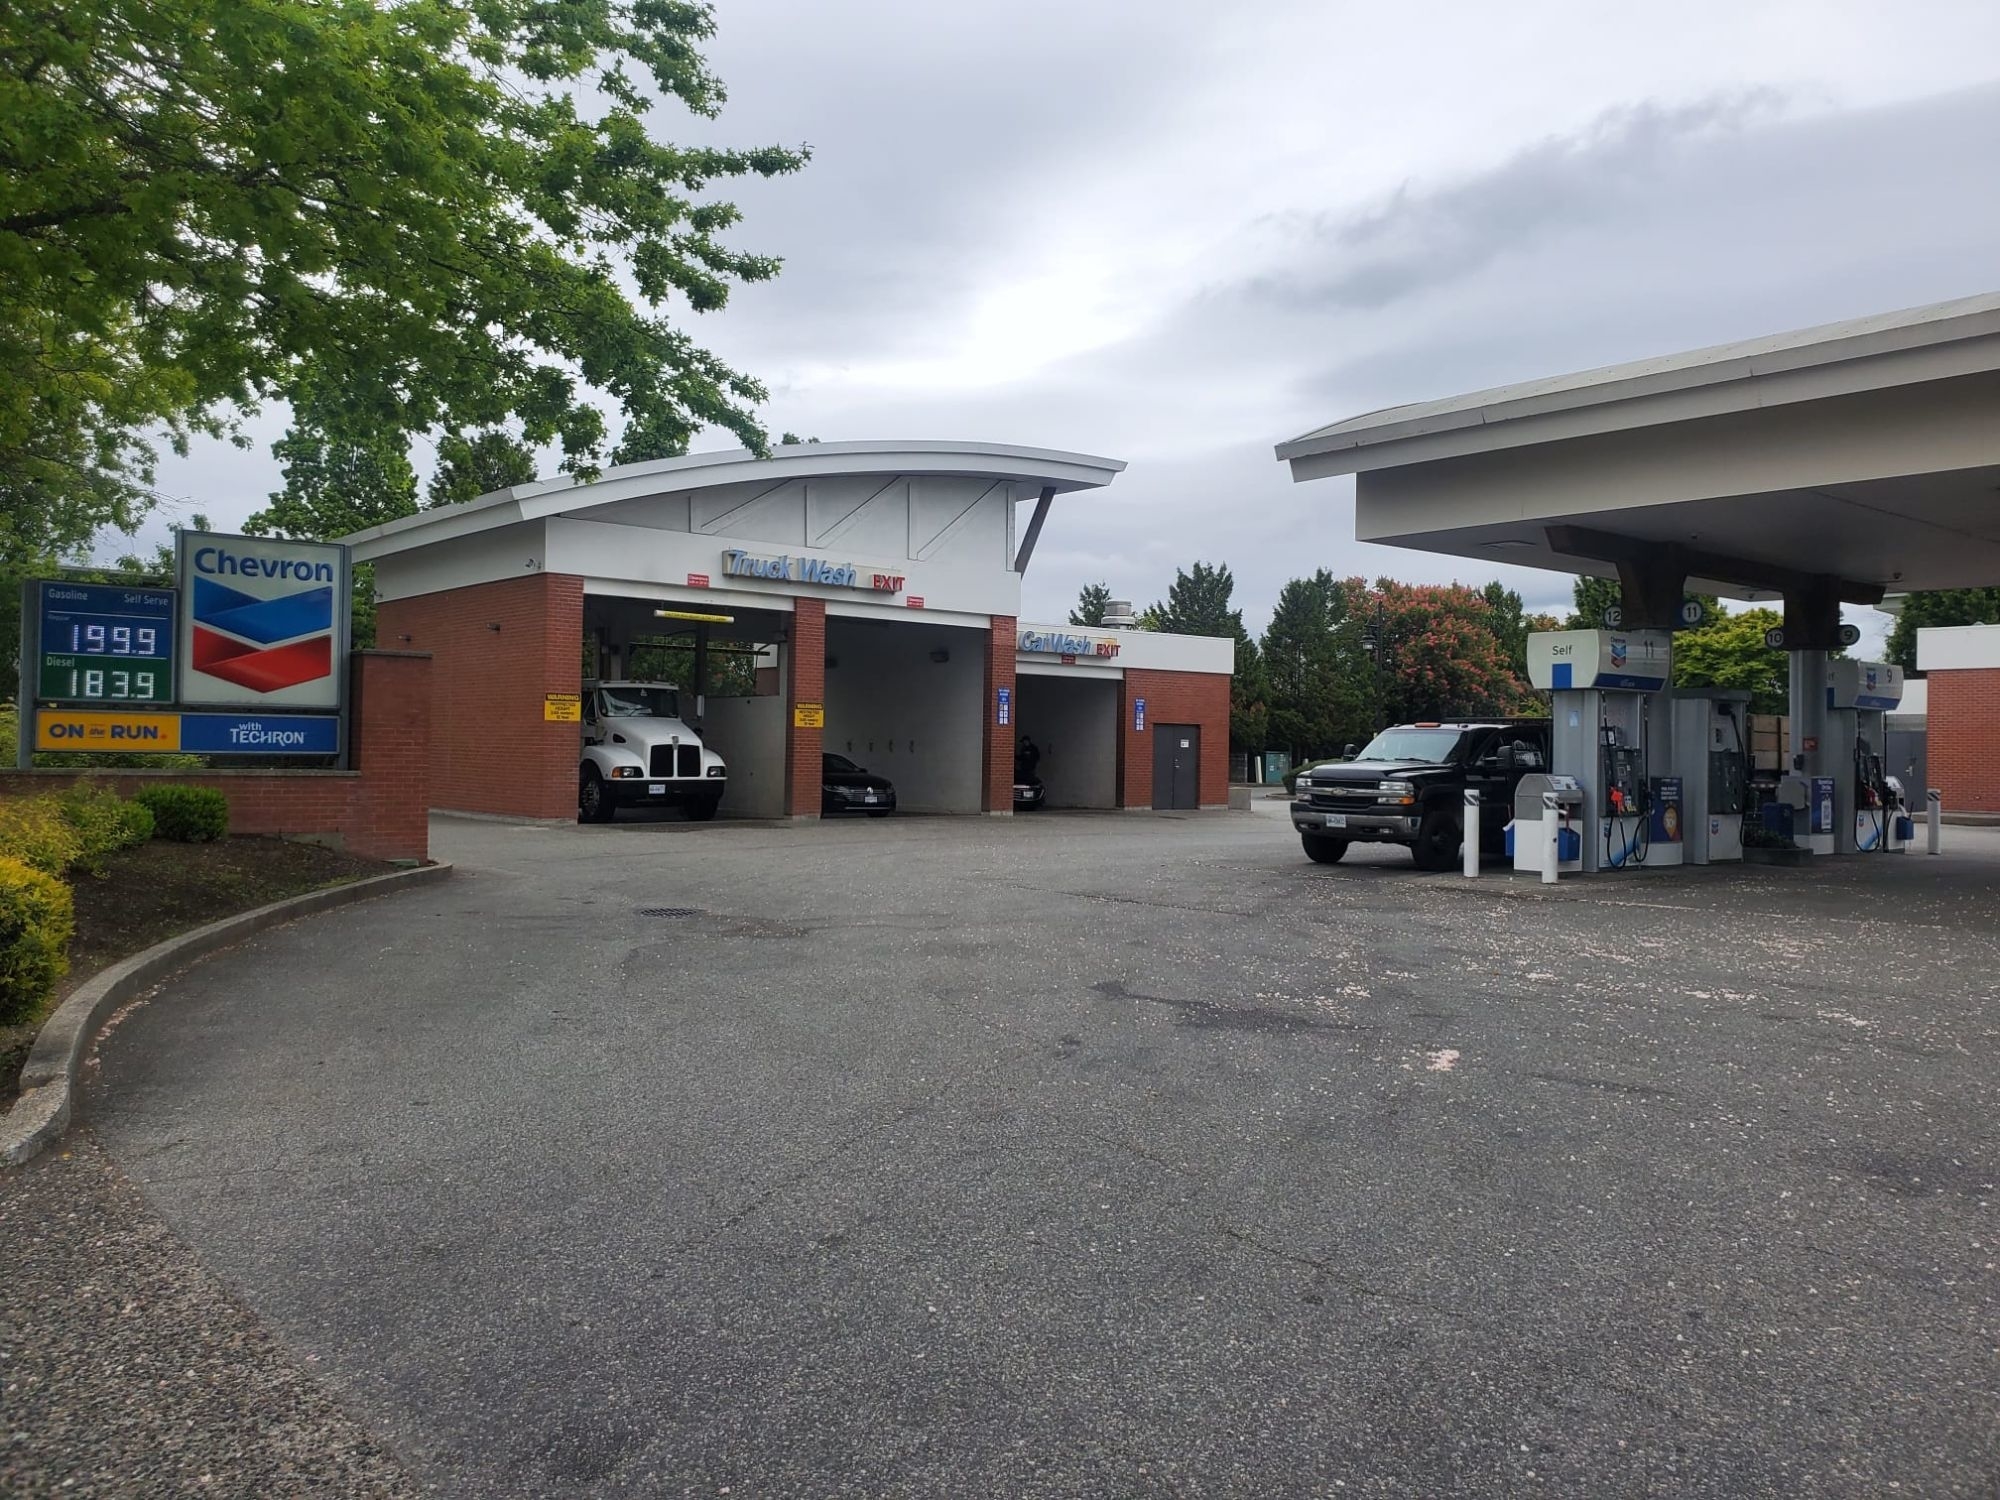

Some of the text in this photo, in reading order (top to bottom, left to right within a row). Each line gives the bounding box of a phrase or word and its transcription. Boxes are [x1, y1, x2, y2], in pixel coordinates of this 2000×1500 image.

[194, 547, 333, 582] Chevron
[728, 550, 905, 592] Truck Wash EXIT
[48, 588, 88, 601] Gasoline
[144, 595, 168, 606] Serve
[1607, 610, 1622, 622] 12
[1687, 606, 1697, 618] 11
[73, 624, 156, 655] 199.9
[1769, 633, 1781, 643] 10
[1844, 630, 1853, 640] 9
[1022, 631, 1121, 657] Car Wash EXIT
[1552, 645, 1573, 656] Self
[46, 656, 75, 668] Diesel
[71, 669, 154, 699] 183.9
[49, 723, 85, 739] ON
[238, 722, 262, 732] with
[230, 727, 304, 747] TECHRON
